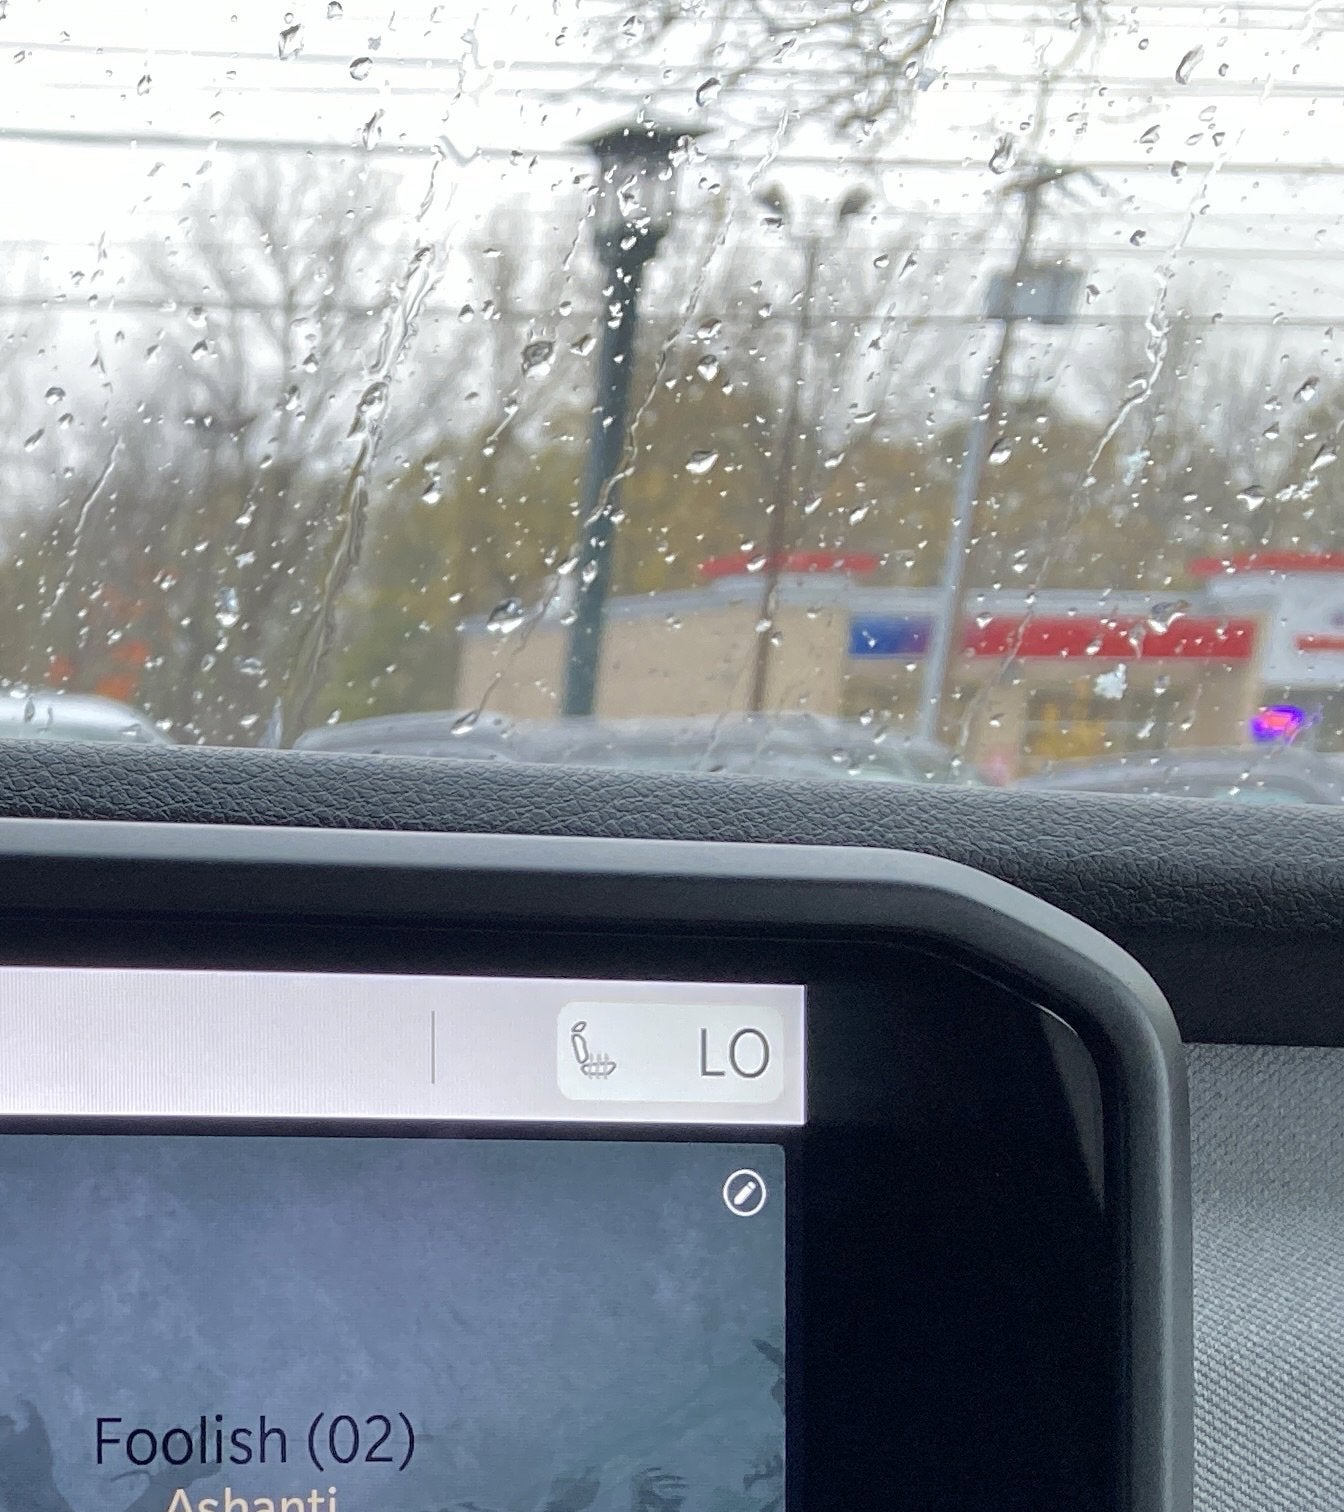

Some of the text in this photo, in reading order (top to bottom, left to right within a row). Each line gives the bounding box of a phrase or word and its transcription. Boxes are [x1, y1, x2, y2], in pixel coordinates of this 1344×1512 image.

[699, 1026, 771, 1079] LO
[93, 1411, 416, 1471] Foolish (02)
